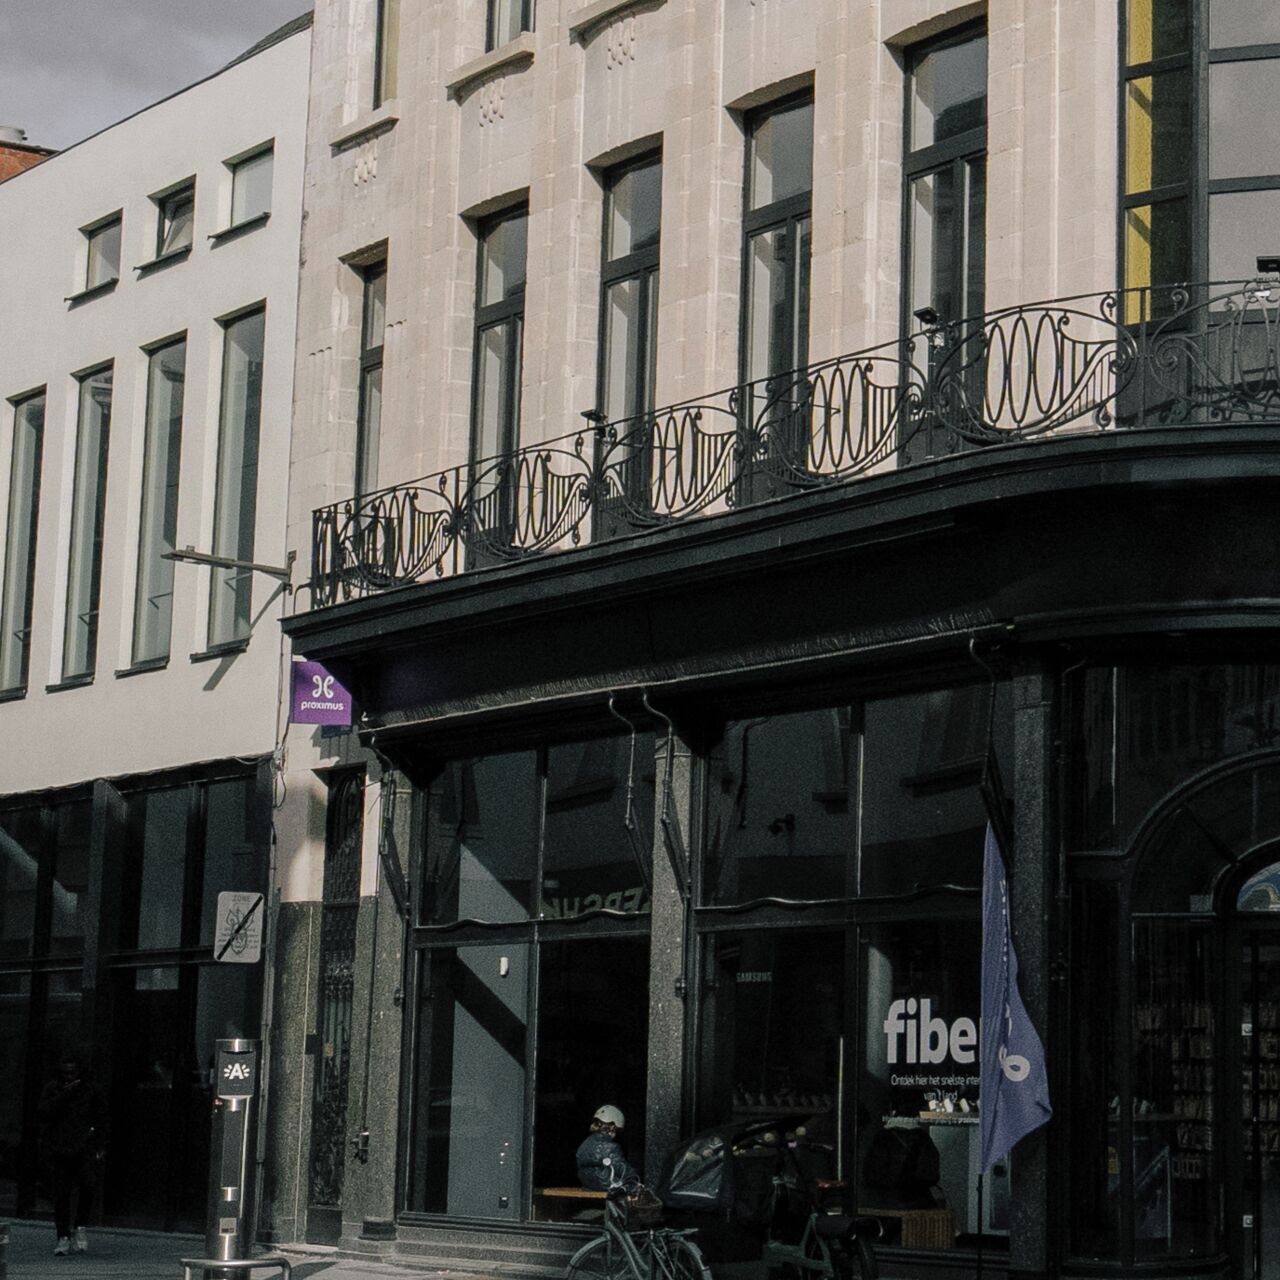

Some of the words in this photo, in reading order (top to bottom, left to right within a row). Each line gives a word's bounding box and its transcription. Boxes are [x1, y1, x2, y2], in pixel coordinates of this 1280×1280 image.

[301, 701, 344, 711] proximus
[232, 894, 251, 903] ZONE
[883, 997, 981, 1065] fibe
[891, 1074, 914, 1086] Ontdek
[915, 1074, 928, 1086] hier
[929, 1074, 941, 1086] het
